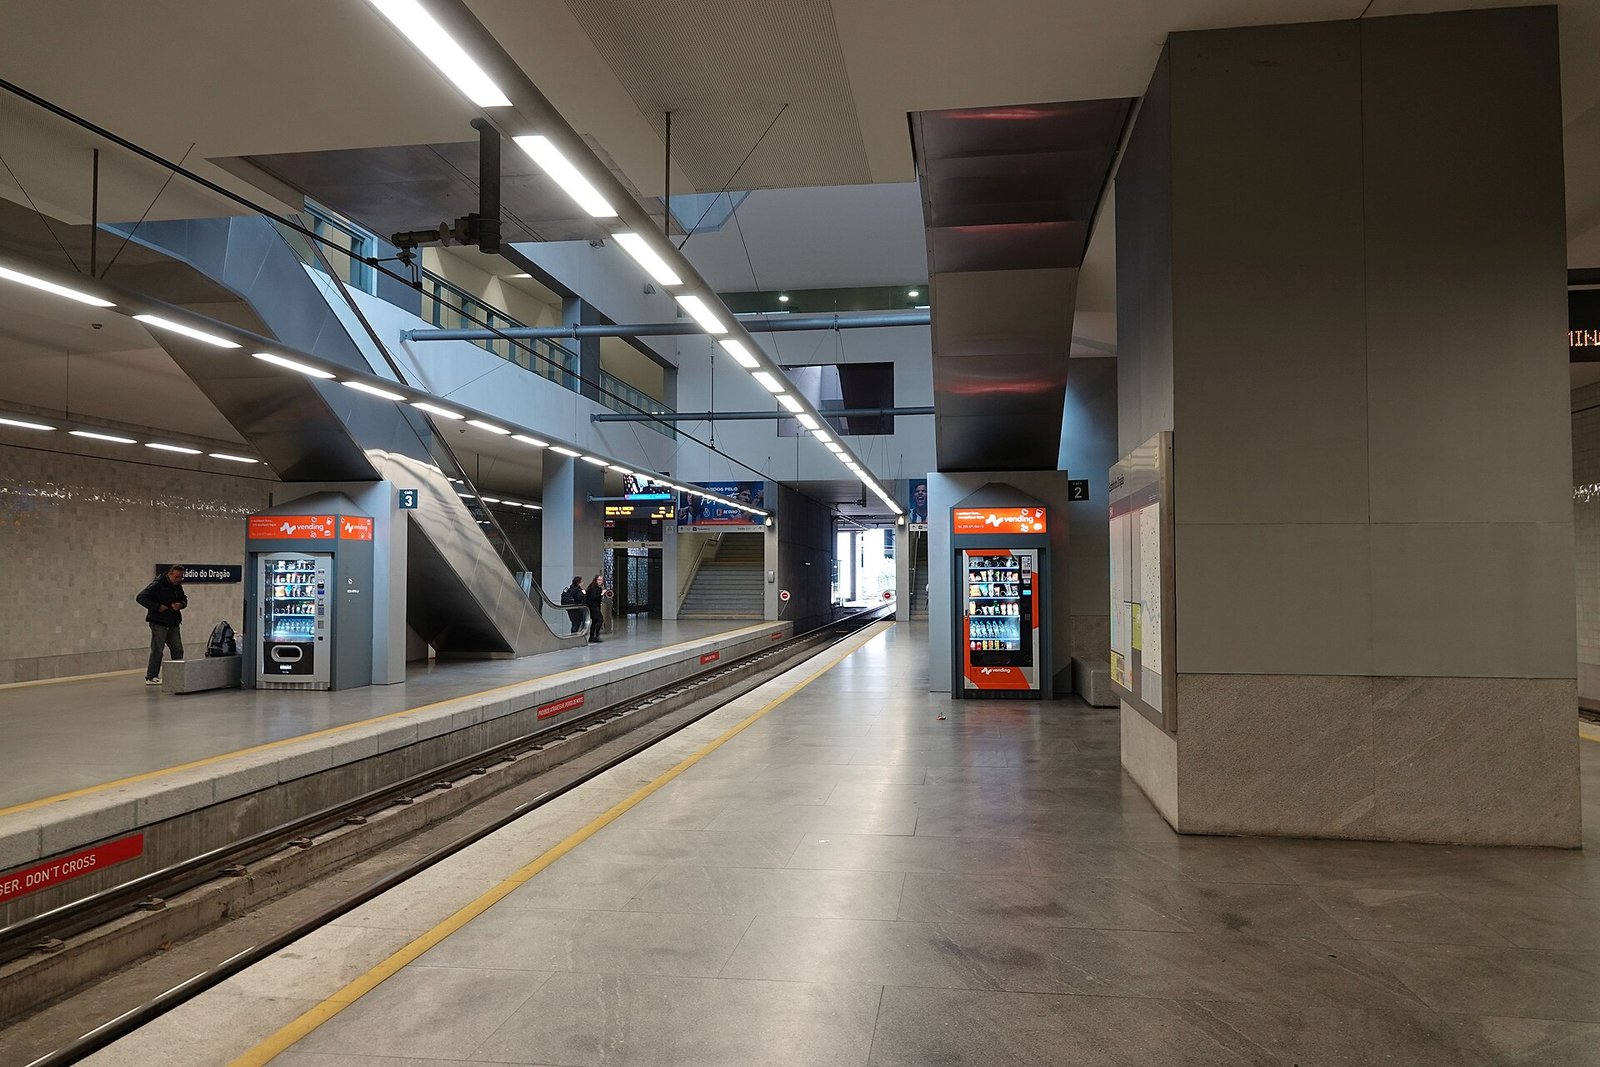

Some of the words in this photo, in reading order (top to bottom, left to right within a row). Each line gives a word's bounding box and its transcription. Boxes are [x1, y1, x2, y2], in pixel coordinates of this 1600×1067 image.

[1074, 486, 1082, 499] 2
[405, 495, 413, 507] 3
[1003, 514, 1034, 523] vending
[296, 523, 324, 531] vending
[199, 569, 208, 578] do
[208, 568, 231, 580] Dragão
[25, 866, 60, 887] DON'T
[62, 854, 96, 875] CROSS
